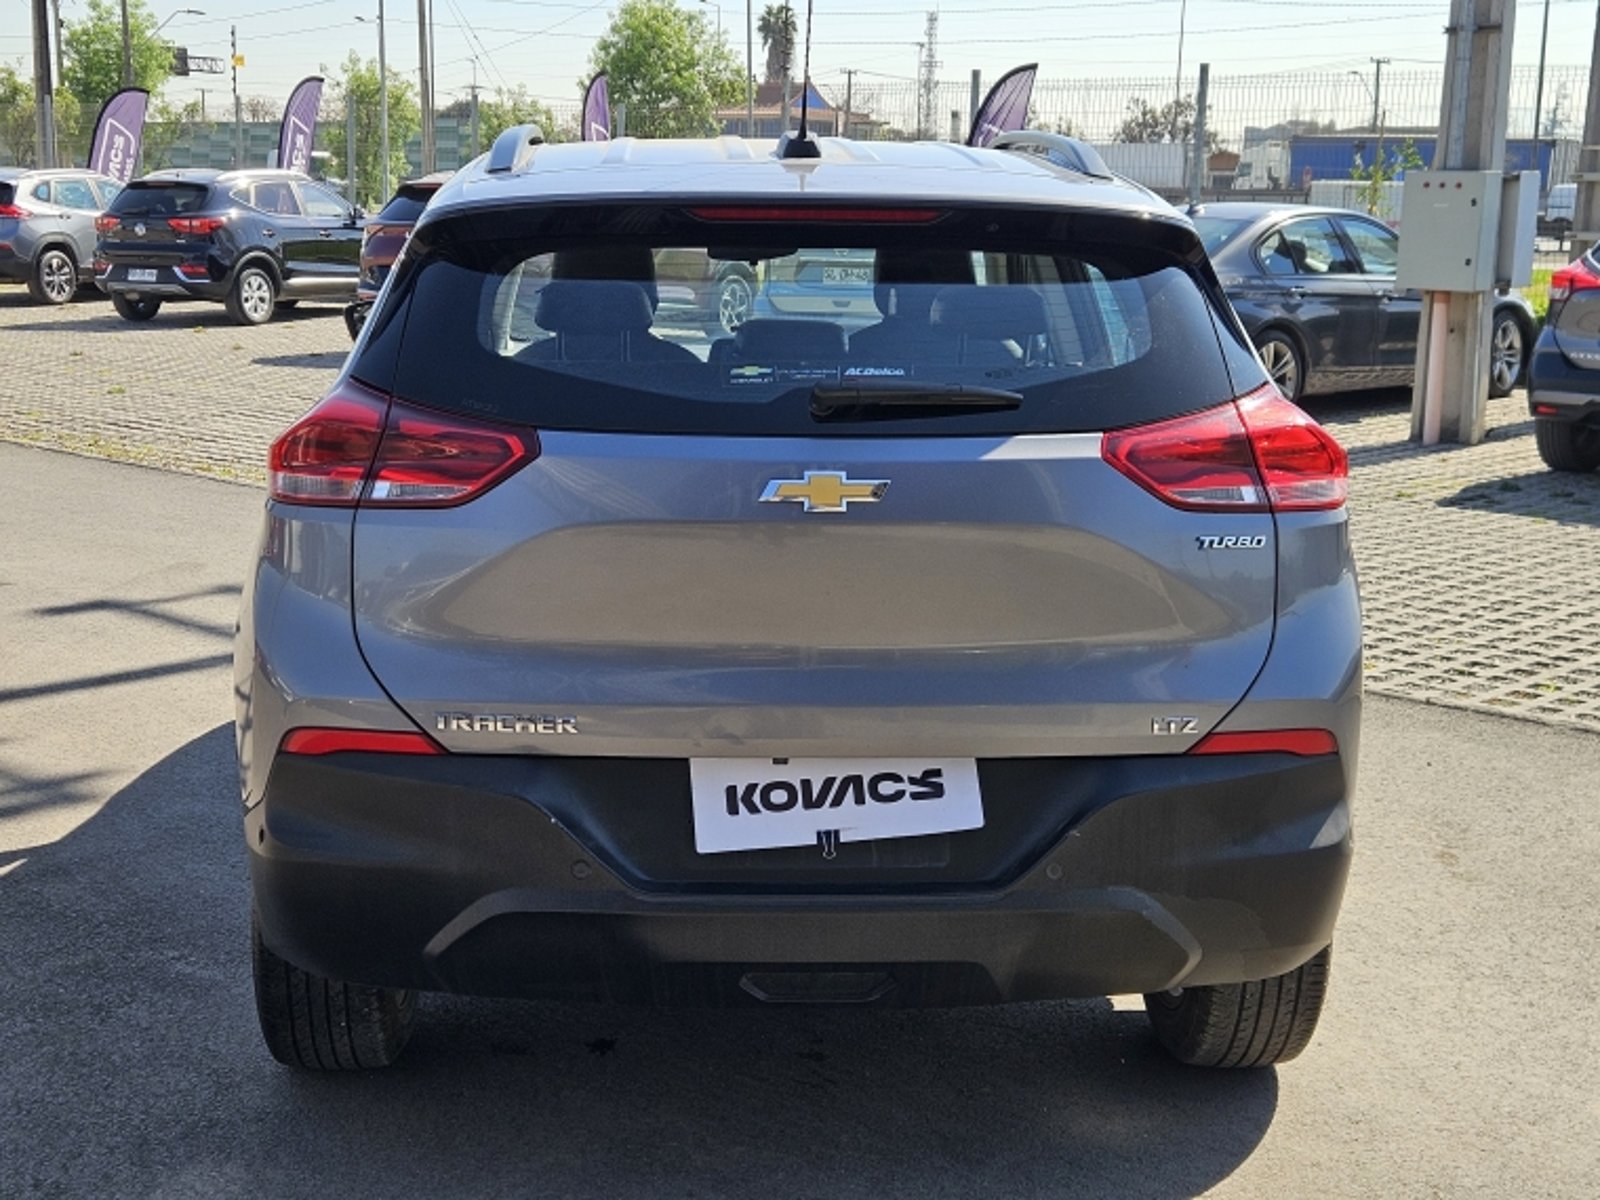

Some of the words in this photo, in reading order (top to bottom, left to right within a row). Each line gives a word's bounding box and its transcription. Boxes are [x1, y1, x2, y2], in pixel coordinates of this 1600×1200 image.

[1196, 535, 1267, 549] TURBO
[434, 711, 578, 734] TRACKER
[1151, 717, 1199, 735] LTZ
[725, 767, 946, 816] KOVACS
